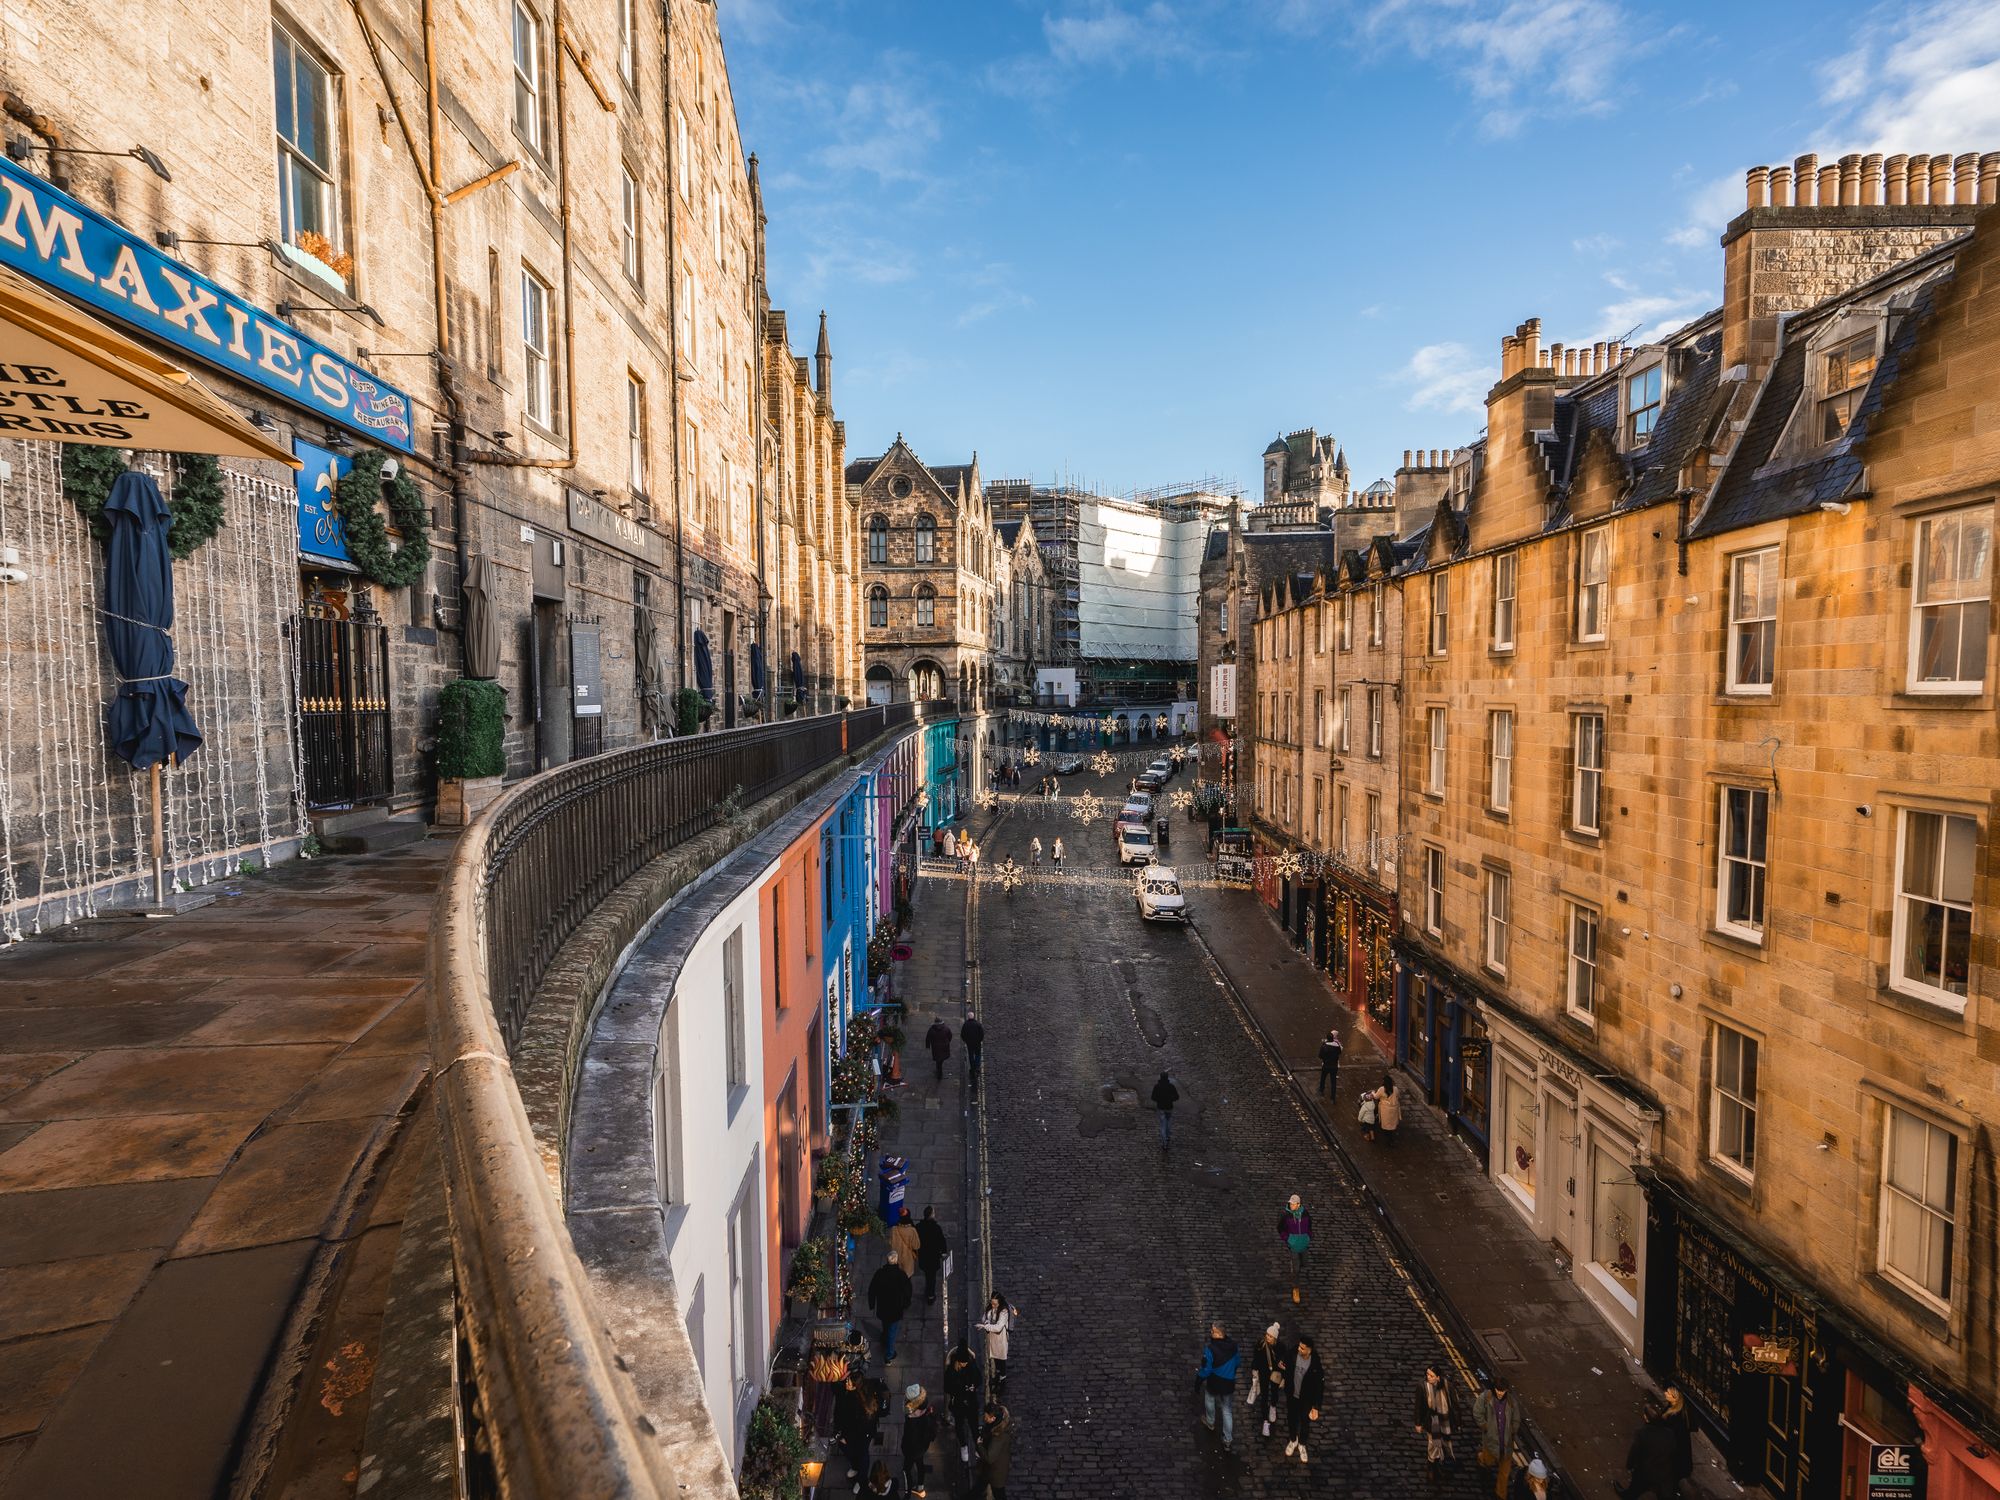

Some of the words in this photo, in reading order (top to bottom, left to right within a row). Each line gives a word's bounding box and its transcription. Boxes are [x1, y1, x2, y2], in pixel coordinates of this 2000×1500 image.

[0, 175, 349, 408] MAXIES
[352, 379, 376, 394] BISTRO
[372, 399, 389, 410] WINE
[357, 412, 403, 428] RESTAURANT
[304, 503, 319, 515] EST.
[1538, 1048, 1583, 1090] SAHARA
[1726, 1250, 1769, 1297] Witchery
[1881, 1447, 1910, 1466] elc
